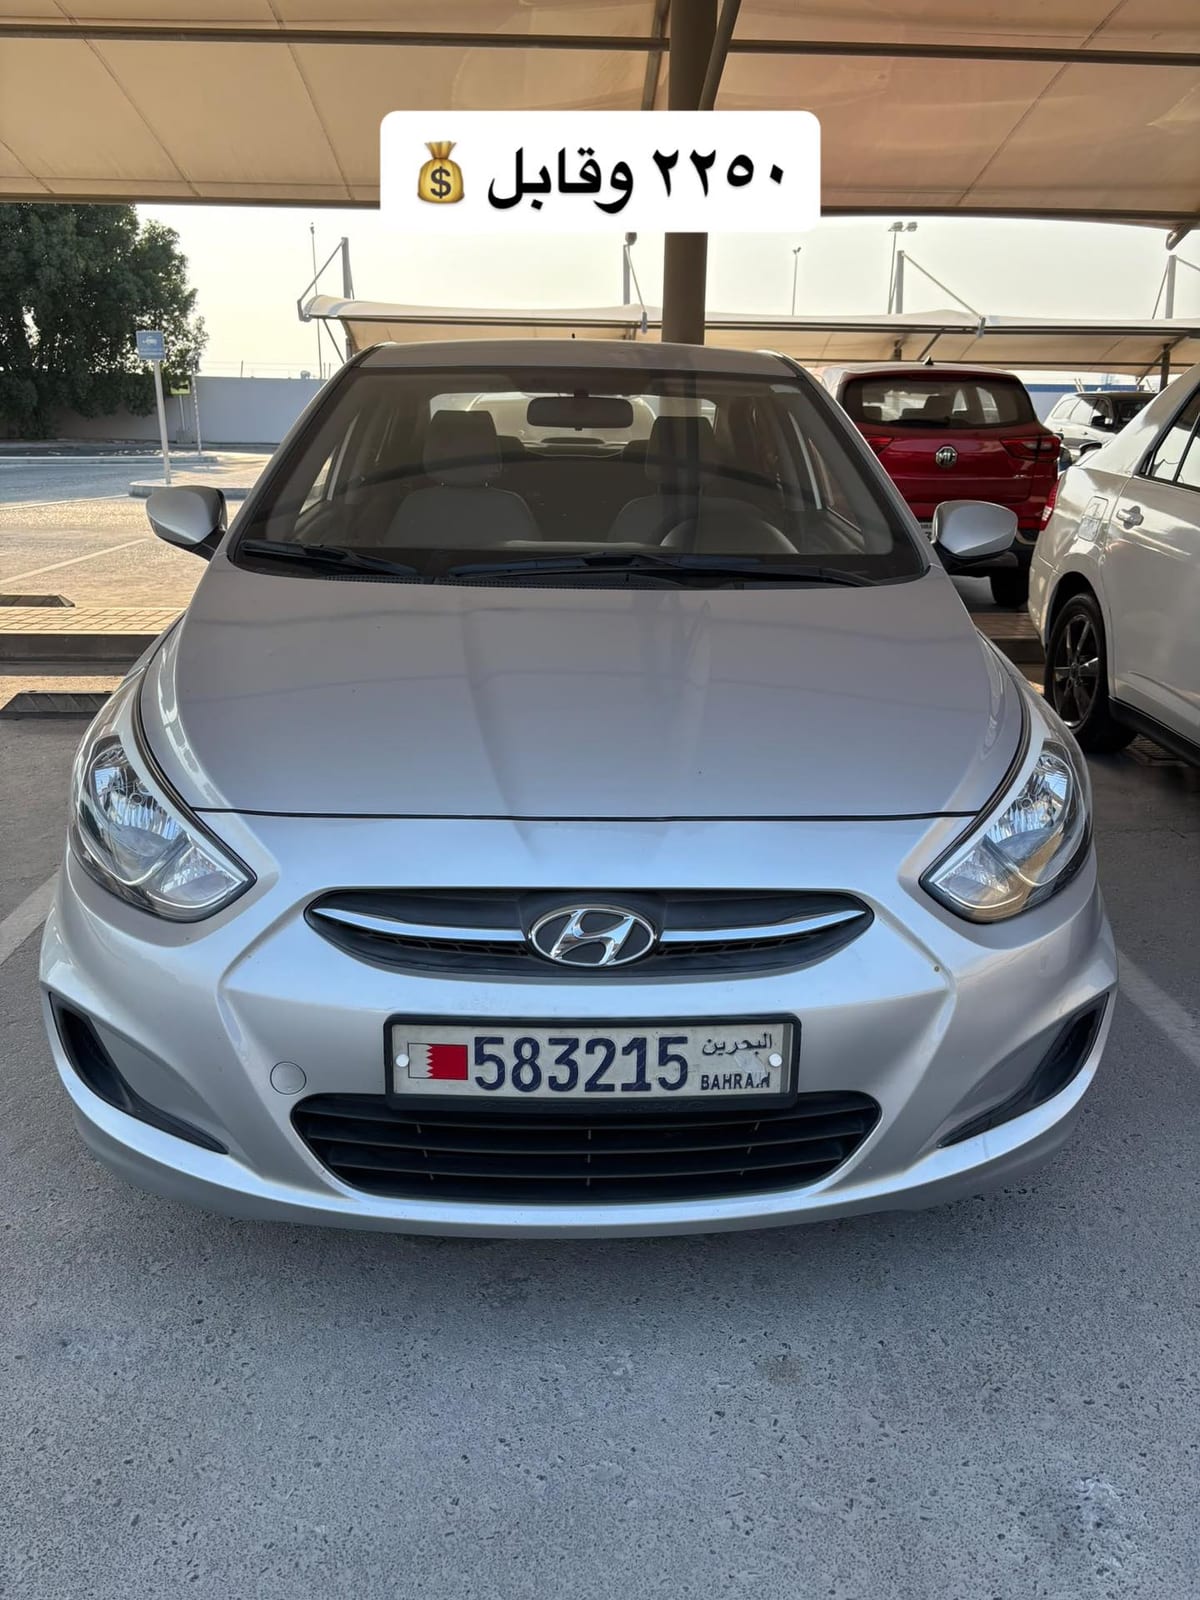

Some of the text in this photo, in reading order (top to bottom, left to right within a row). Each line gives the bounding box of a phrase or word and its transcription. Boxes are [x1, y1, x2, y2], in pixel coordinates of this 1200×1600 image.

[702, 1032, 773, 1057] البحرين
[473, 1036, 689, 1093] 583215
[700, 1071, 771, 1091] BAHRAN
